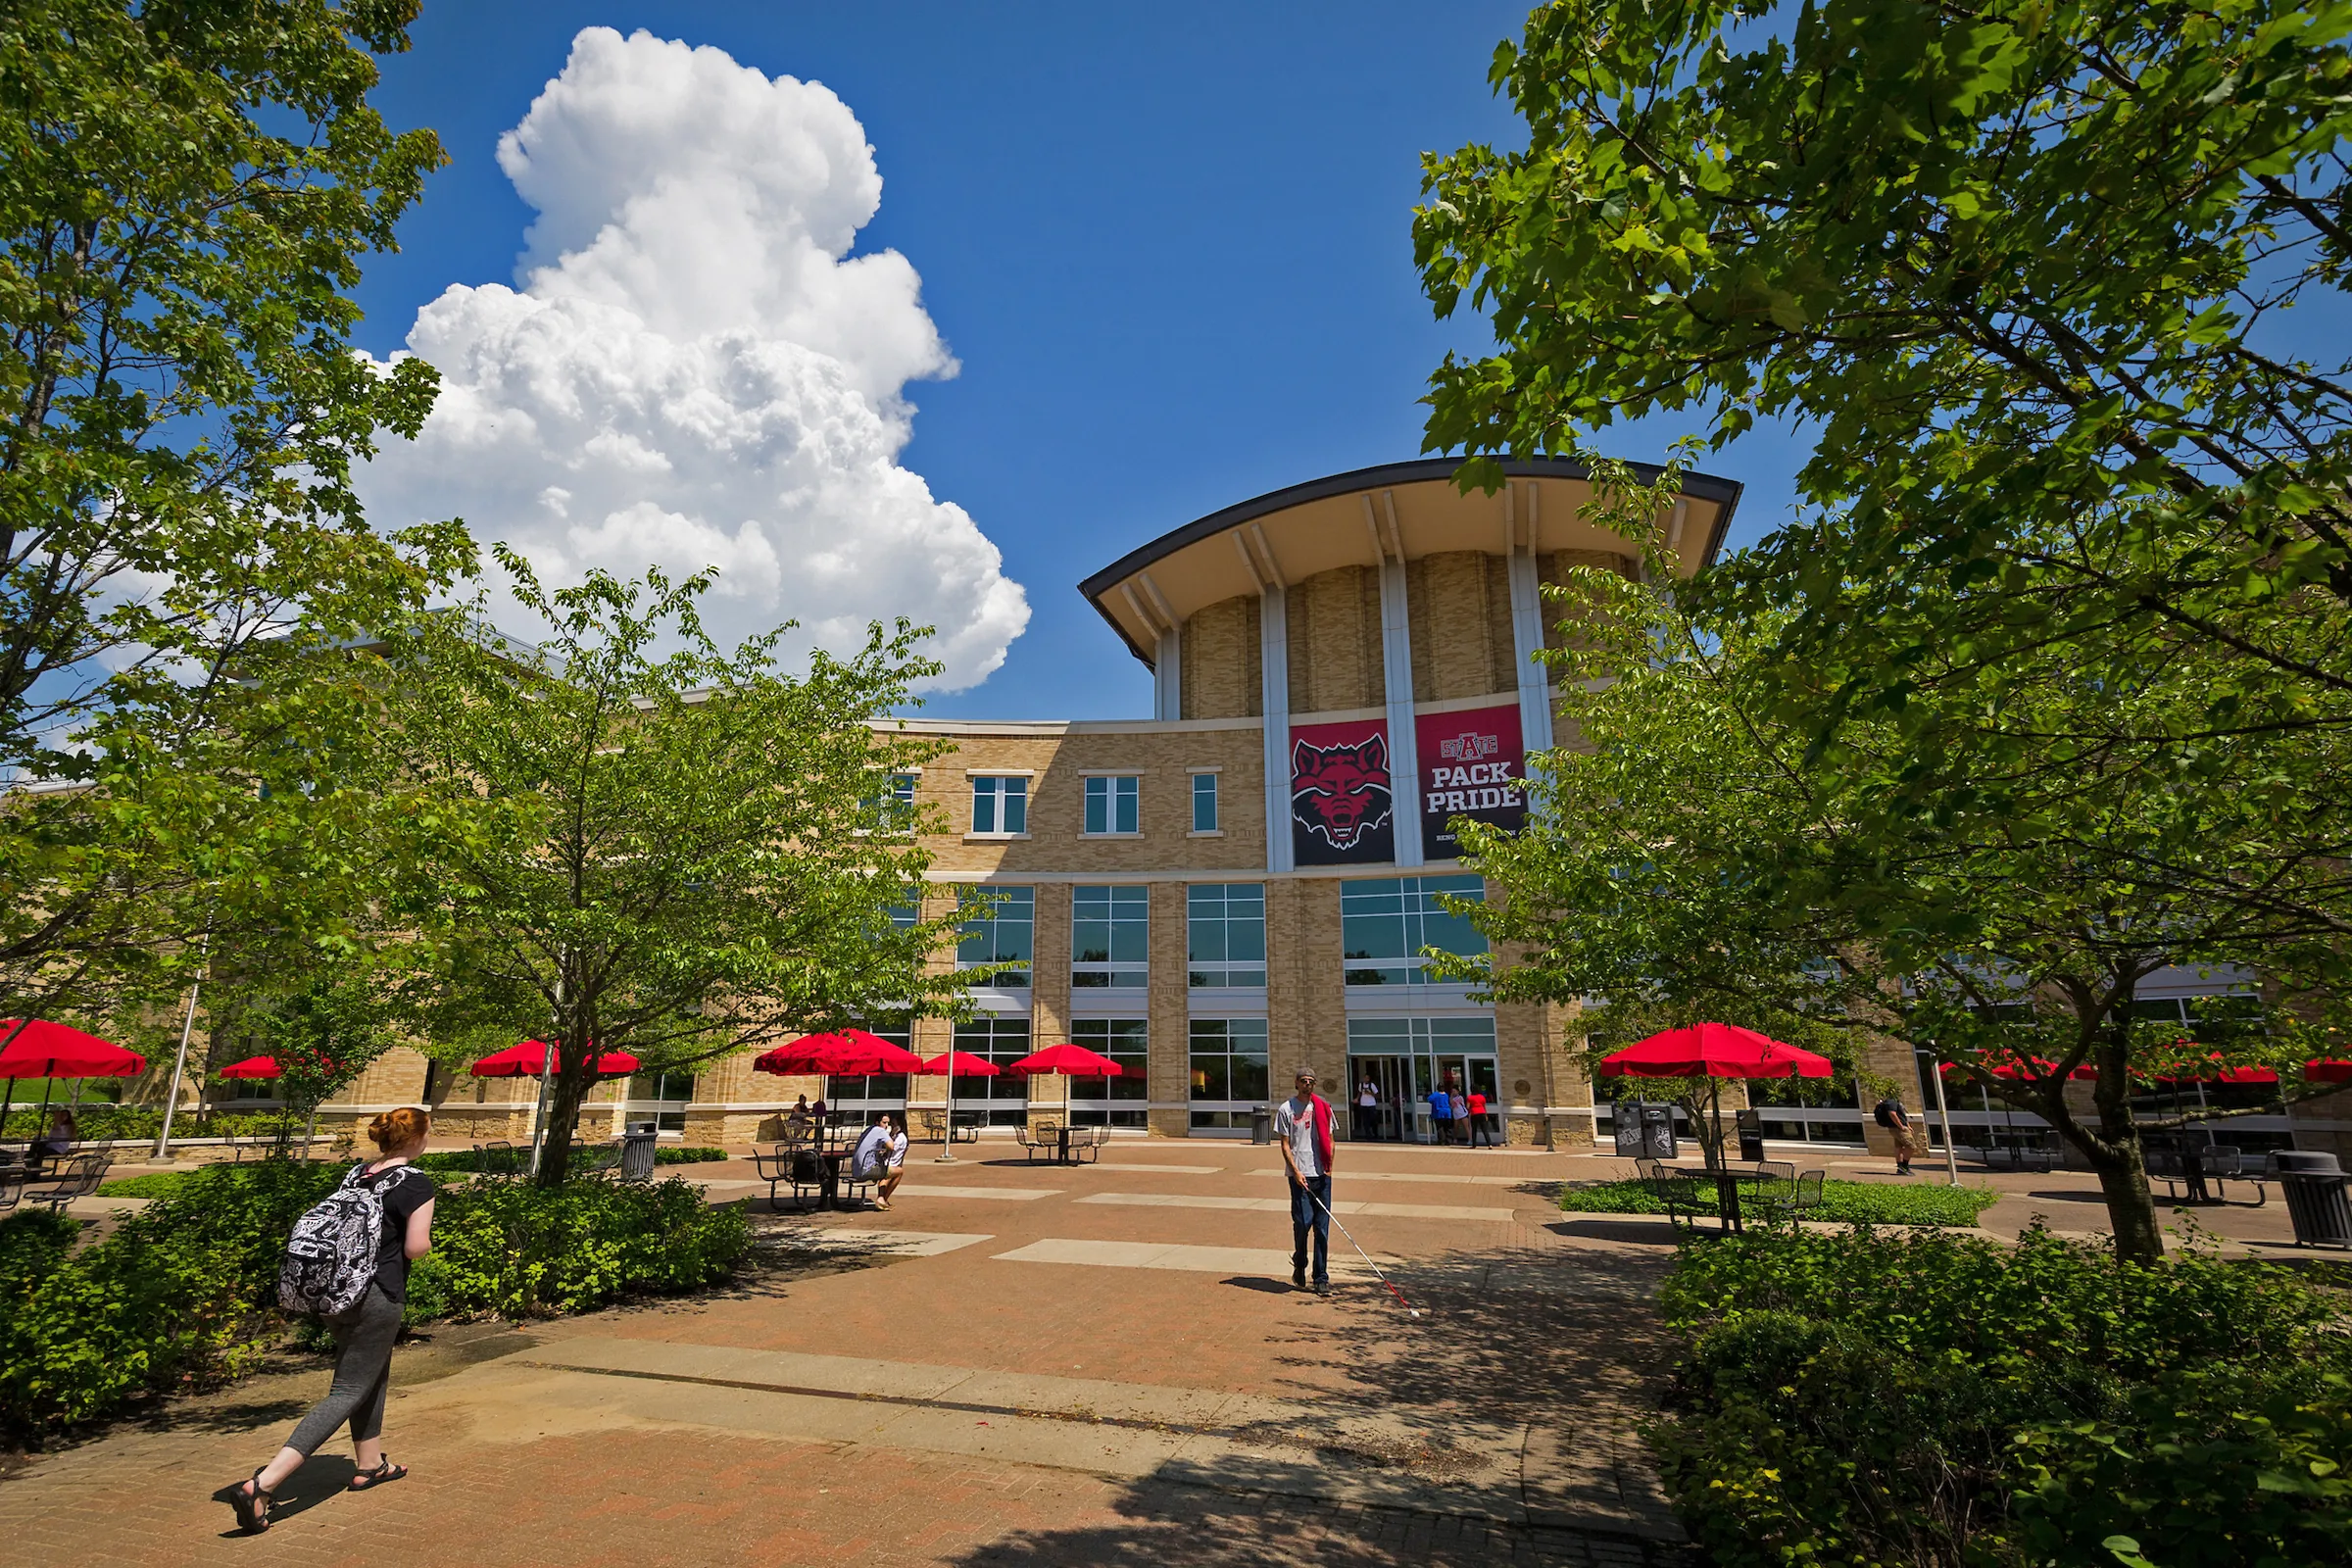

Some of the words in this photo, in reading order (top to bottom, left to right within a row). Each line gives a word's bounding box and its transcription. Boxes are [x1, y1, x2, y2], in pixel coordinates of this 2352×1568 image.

[1441, 732, 1497, 761] STATE
[1432, 761, 1511, 788] PACK
[1427, 786, 1521, 813] PRIDE
